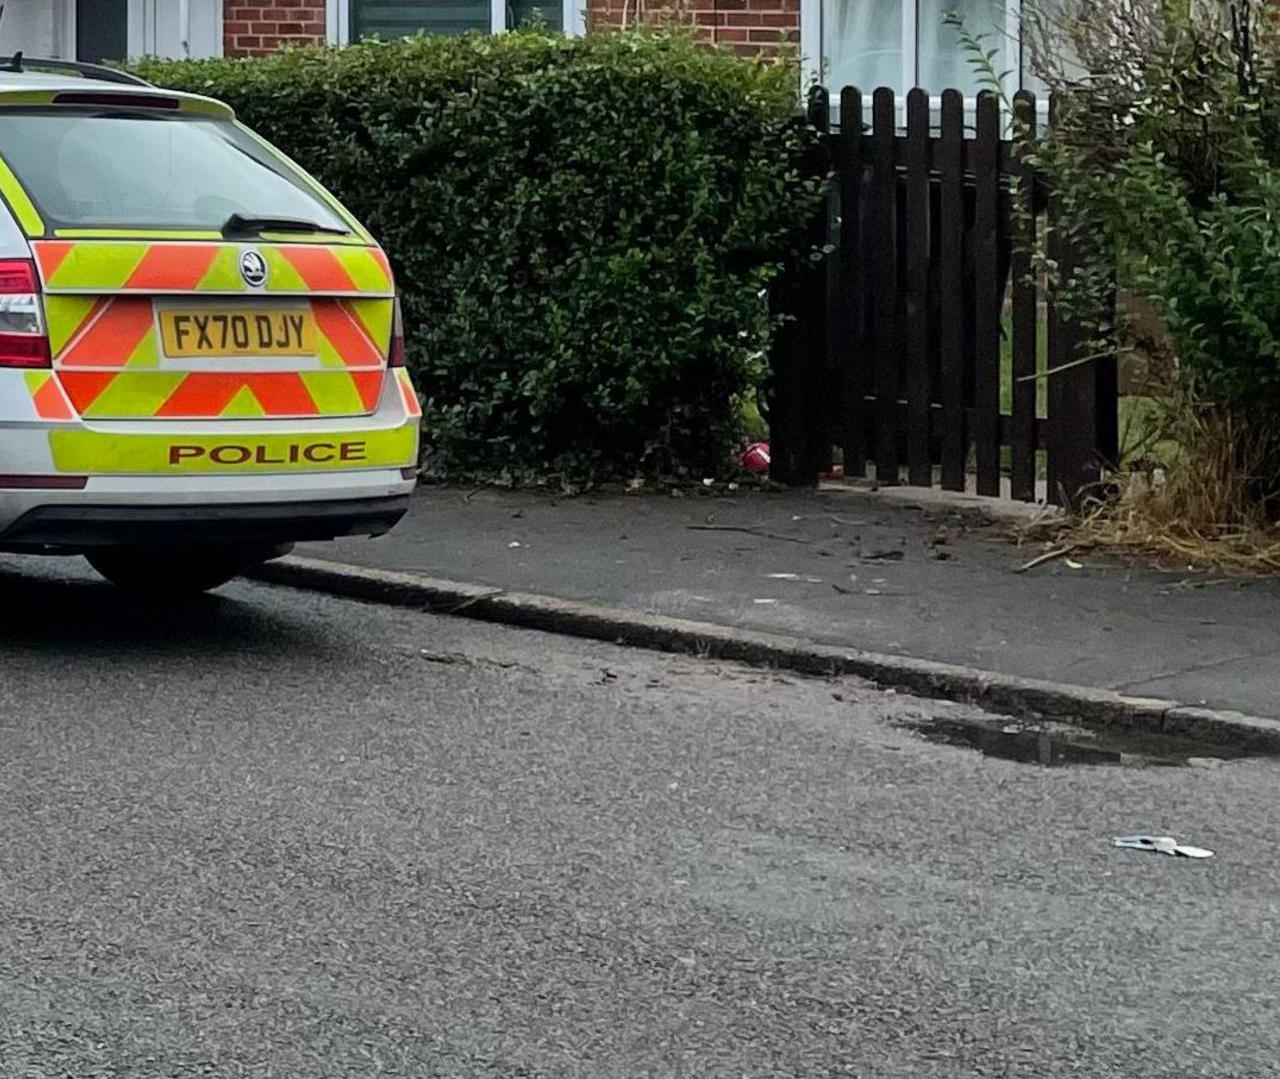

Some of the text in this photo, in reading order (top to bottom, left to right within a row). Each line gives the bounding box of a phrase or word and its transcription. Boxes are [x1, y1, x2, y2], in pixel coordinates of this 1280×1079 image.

[173, 314, 304, 350] FX70 DJY
[168, 441, 367, 465] POLICE
